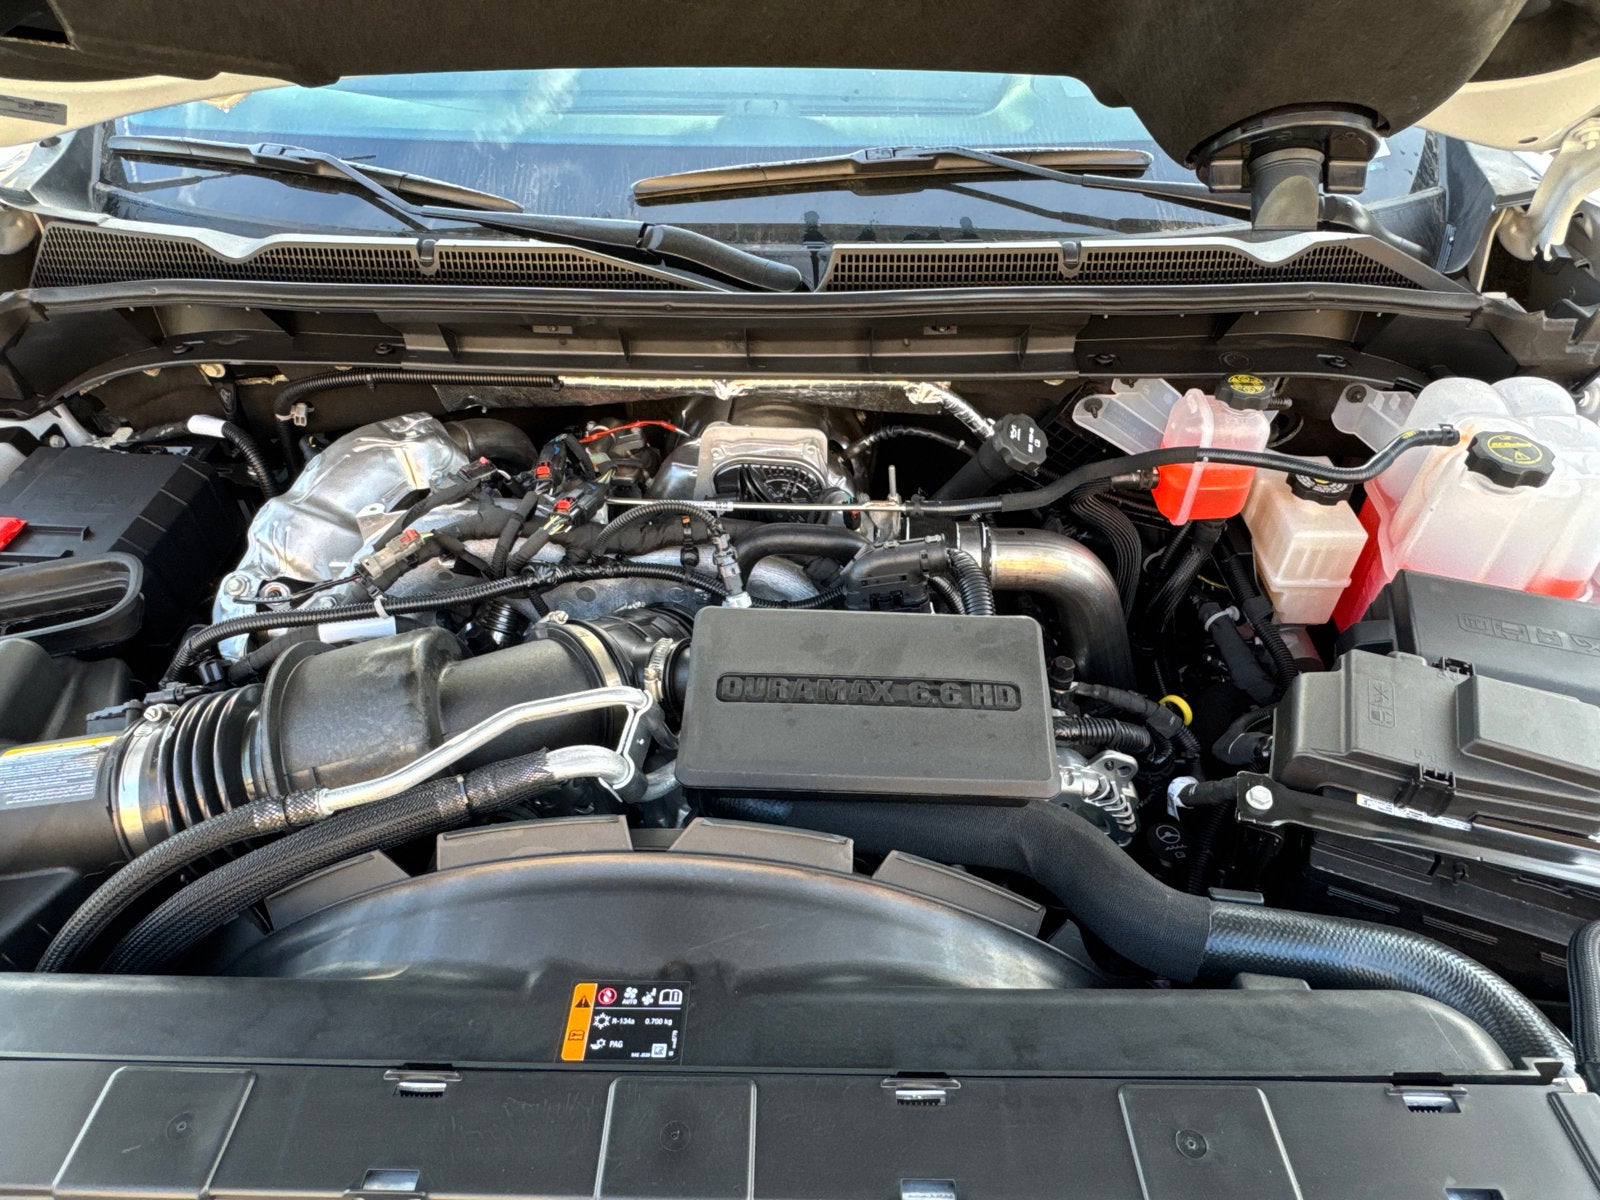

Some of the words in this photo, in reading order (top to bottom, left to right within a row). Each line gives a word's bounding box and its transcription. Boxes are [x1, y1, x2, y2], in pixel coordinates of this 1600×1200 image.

[721, 676, 895, 703] DURAMAX
[908, 681, 962, 705] 6.6
[971, 683, 1017, 708] HD
[609, 1040, 624, 1048] PAG
